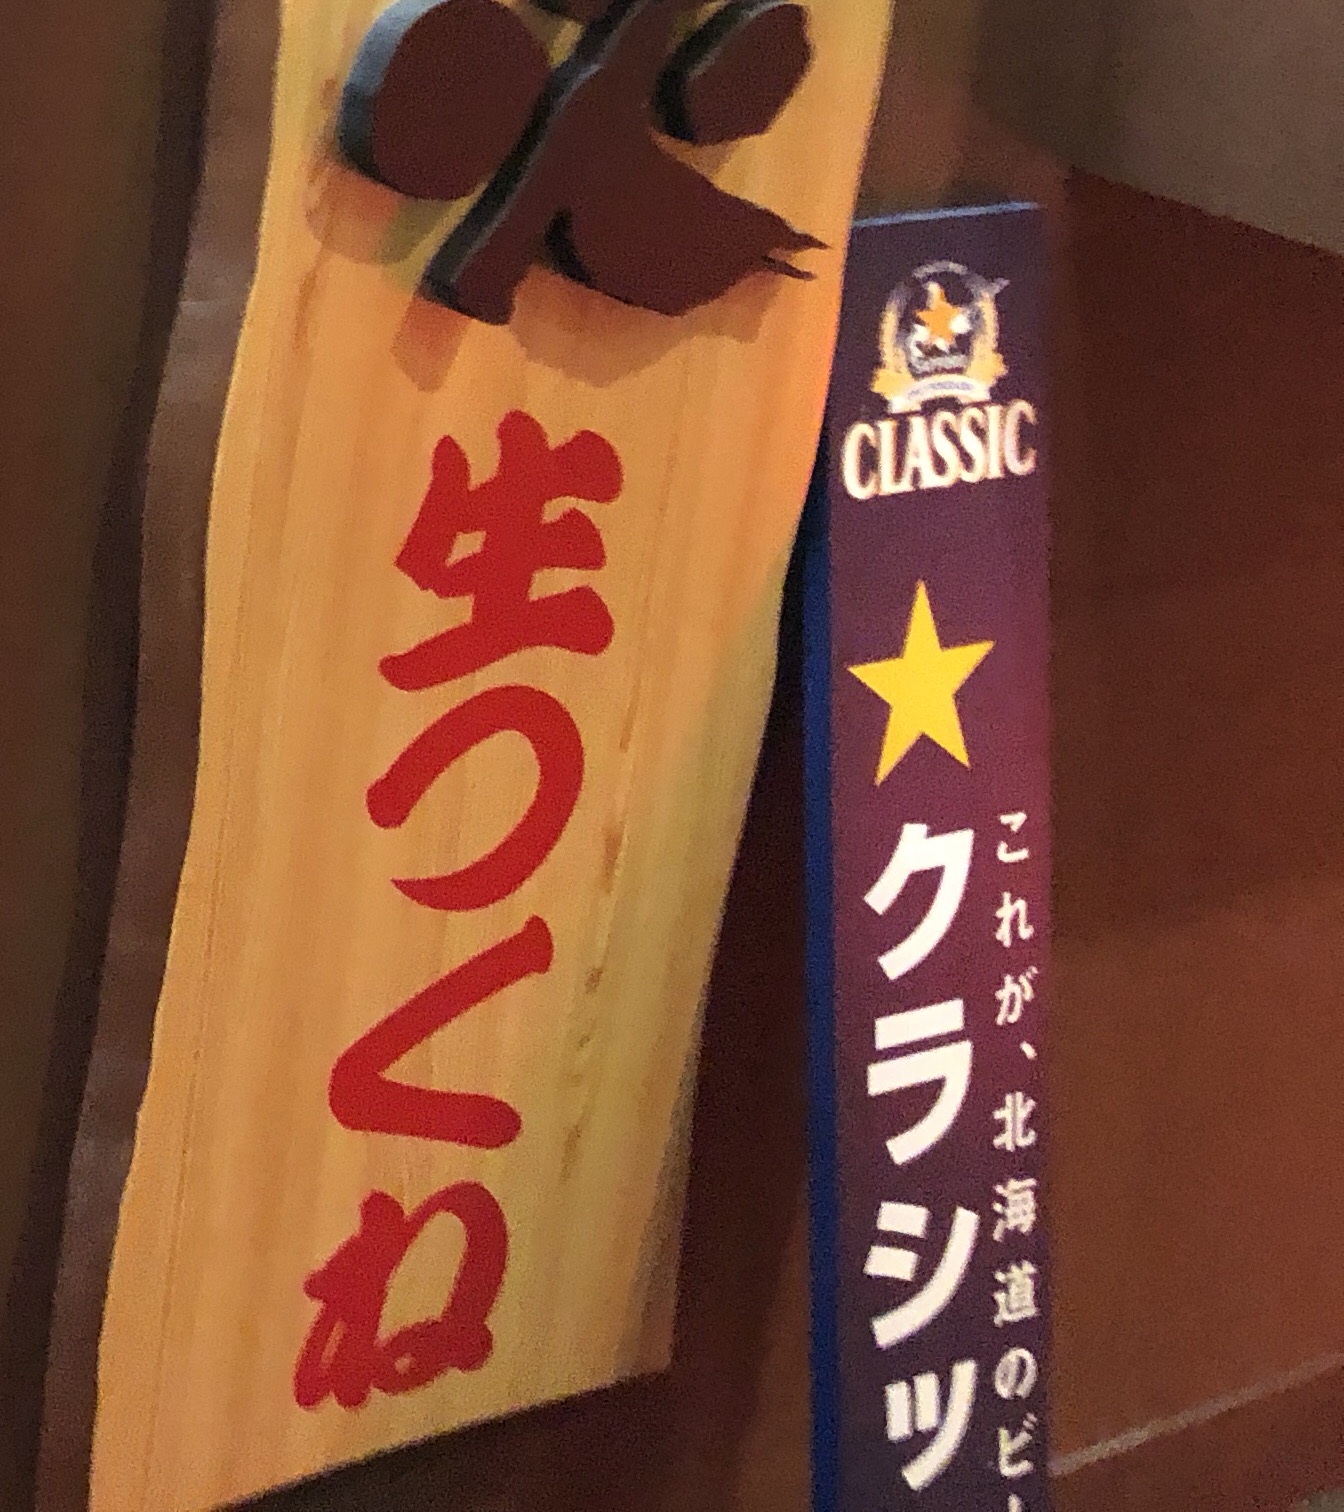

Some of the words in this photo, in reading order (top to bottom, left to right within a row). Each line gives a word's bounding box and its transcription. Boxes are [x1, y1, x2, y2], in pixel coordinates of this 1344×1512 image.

[841, 398, 1039, 501] CLASSIC
[293, 409, 623, 1410] 生つくね
[992, 811, 1039, 1512] これが、北海道のビ
